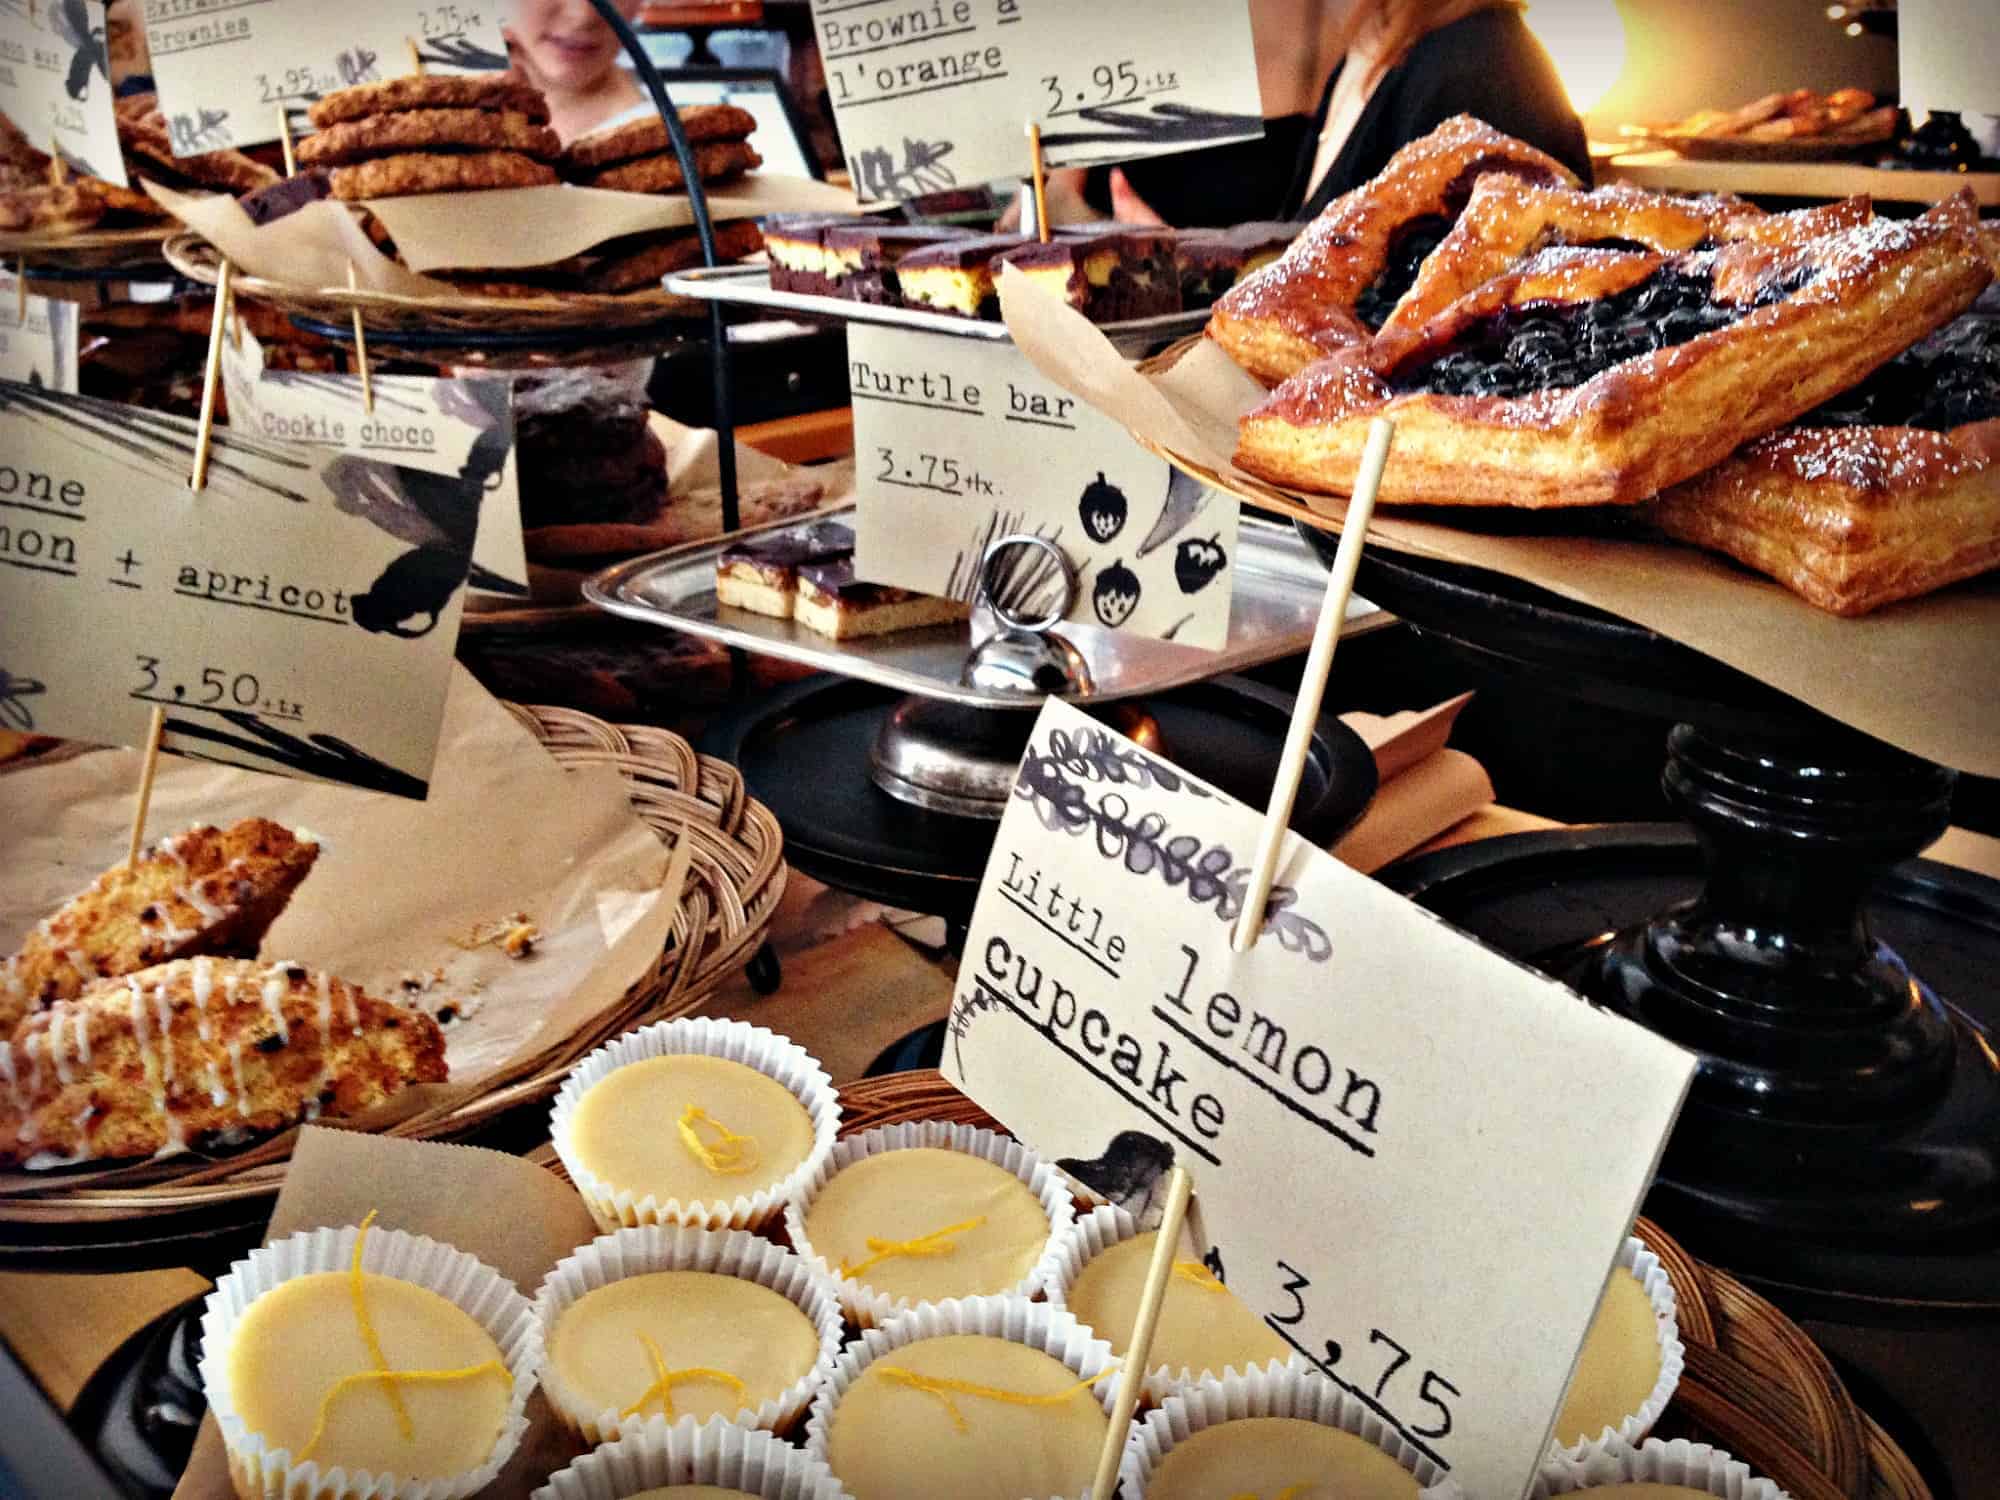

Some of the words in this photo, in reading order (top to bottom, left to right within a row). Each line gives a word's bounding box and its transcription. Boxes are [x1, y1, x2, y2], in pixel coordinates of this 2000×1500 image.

[821, 0, 971, 50] Brownie
[832, 46, 1002, 98] l'orange
[852, 362, 981, 405] Turtle
[1008, 384, 1075, 418] bar
[262, 412, 345, 439] Cookie
[360, 420, 435, 445] choco
[176, 565, 349, 615] apricot
[1001, 851, 1126, 962] Little
[1164, 944, 1383, 1134] lemon
[984, 936, 1225, 1139] cupcake
